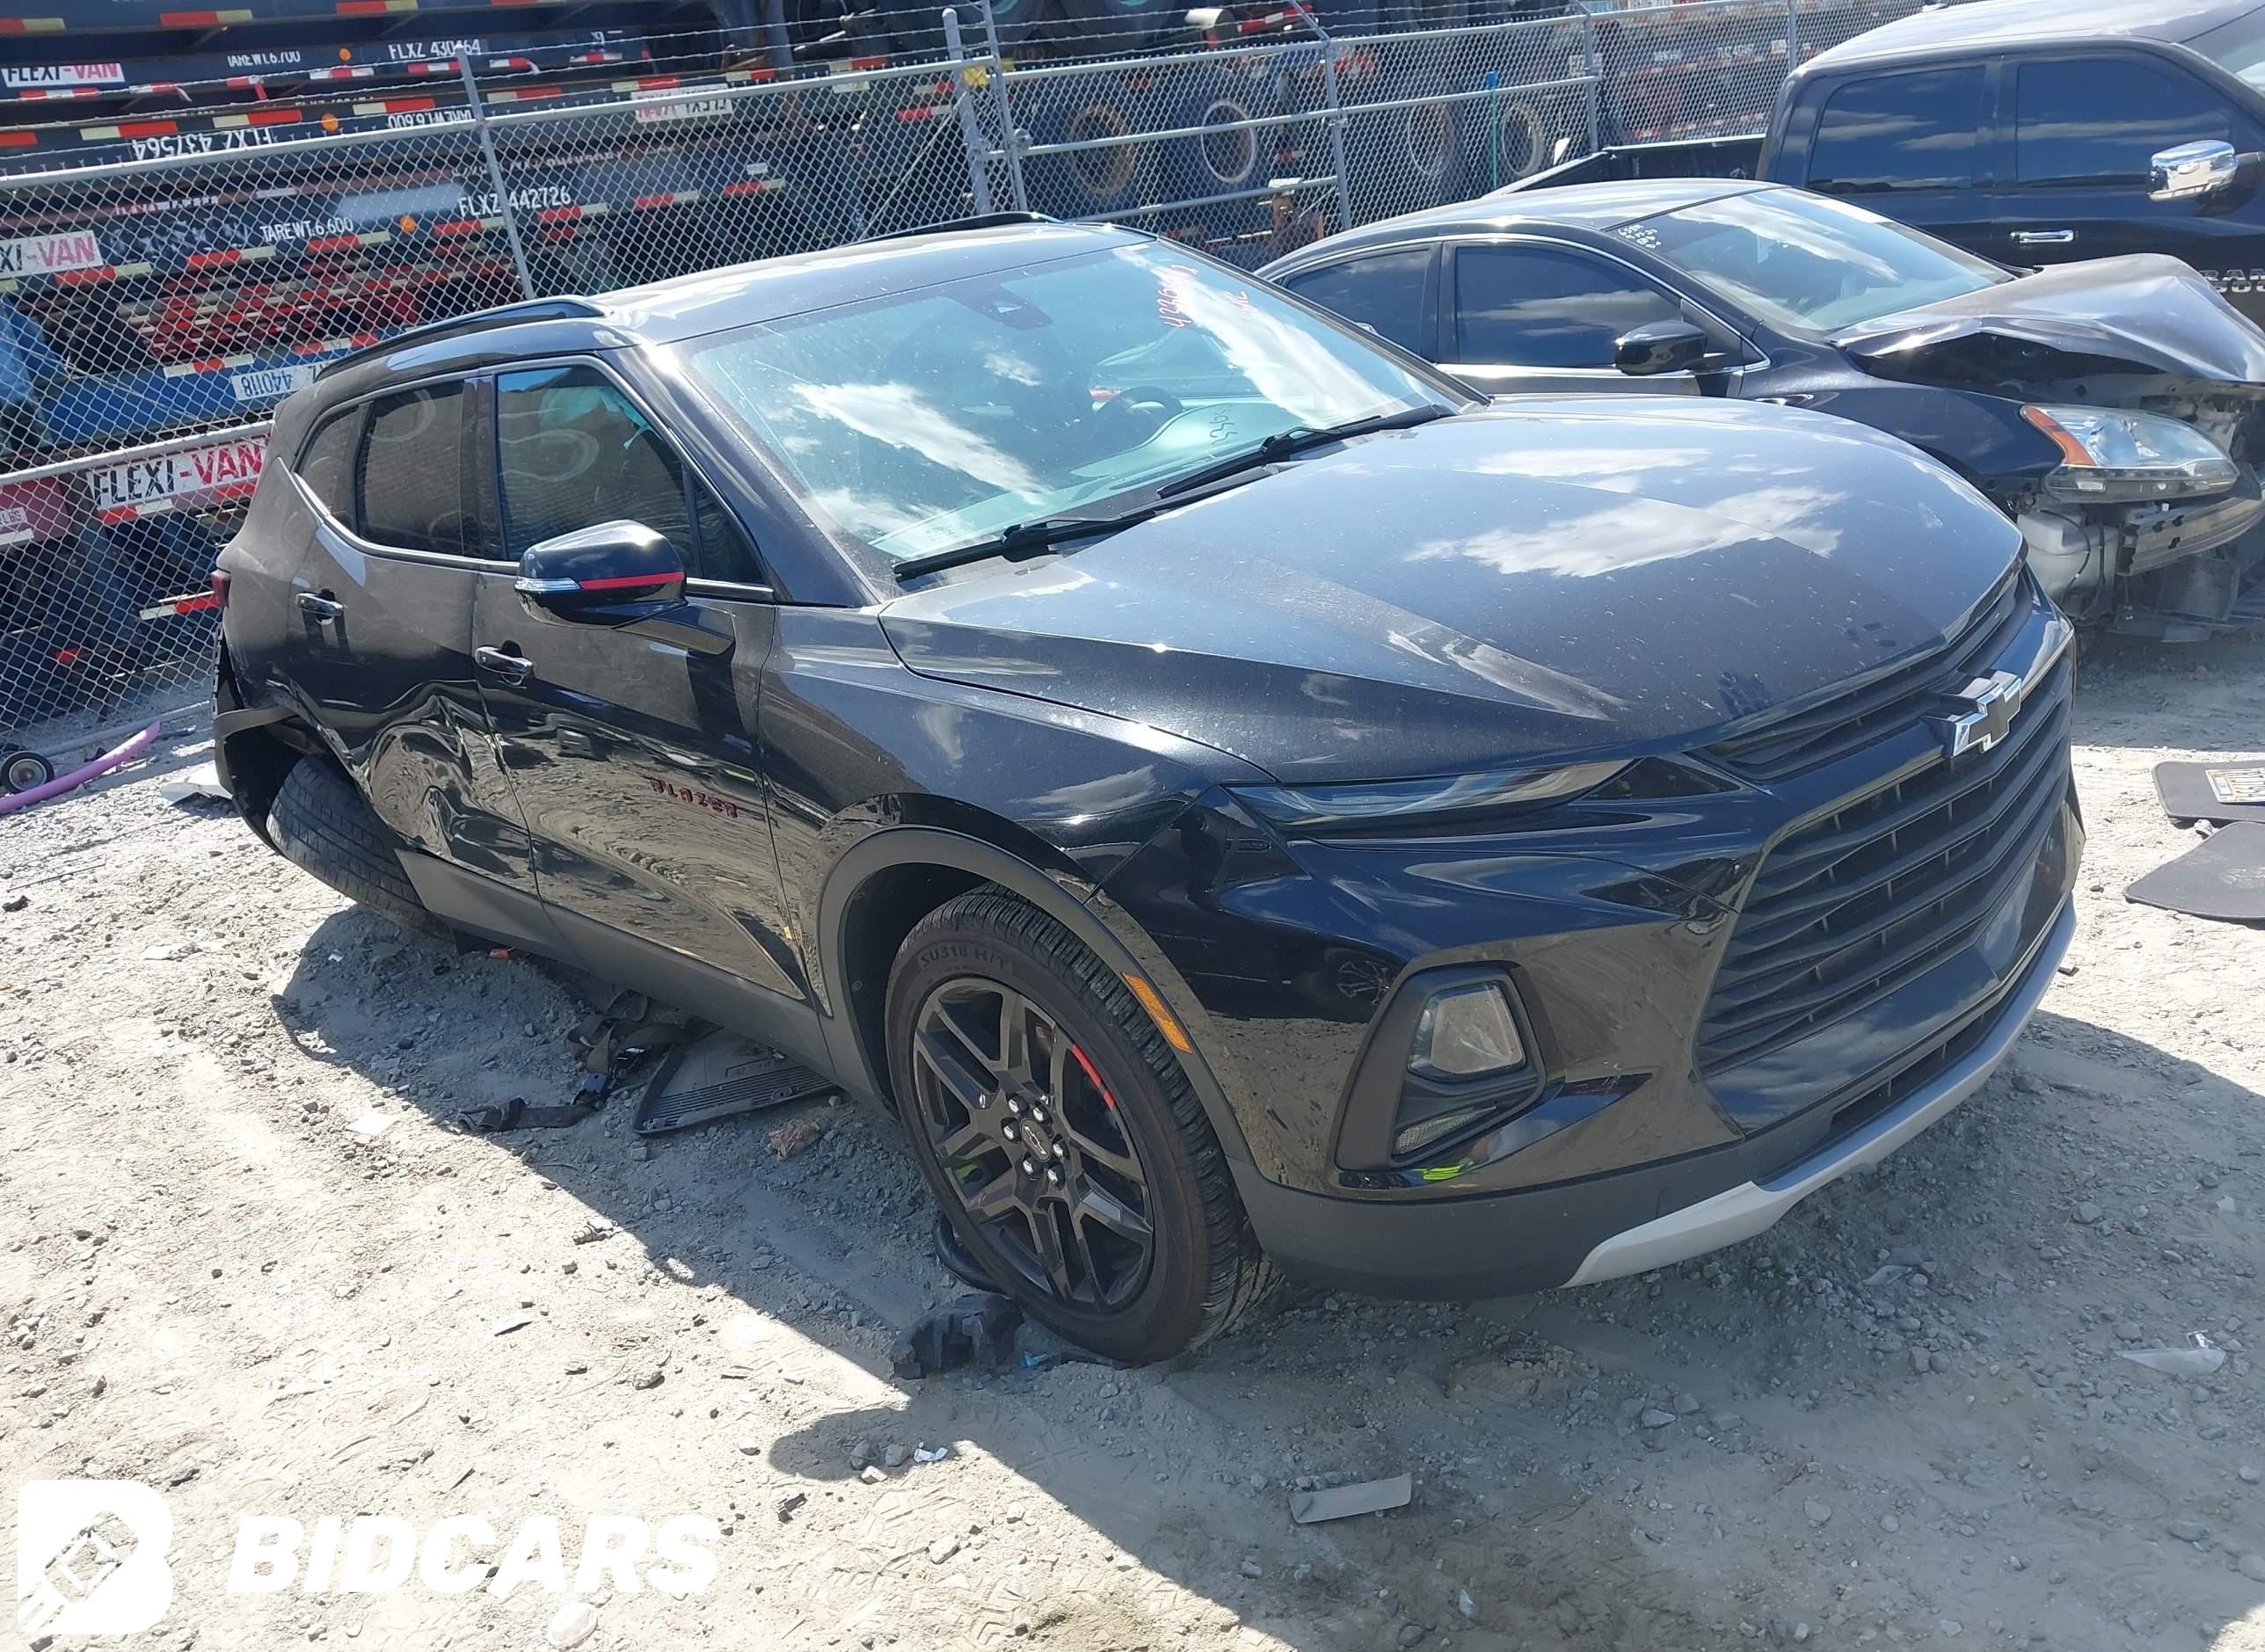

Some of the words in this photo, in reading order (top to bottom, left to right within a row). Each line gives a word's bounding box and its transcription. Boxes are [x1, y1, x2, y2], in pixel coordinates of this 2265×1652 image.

[389, 42, 426, 60] FLXZ
[7, 62, 119, 82] FLEXI-VAN
[132, 133, 213, 161] 437564
[457, 193, 502, 217] FLXZ
[508, 185, 572, 211] 442726
[0, 235, 95, 273] XI-VAN
[240, 370, 292, 397] 440118
[93, 442, 263, 506] FLEXI-VAN
